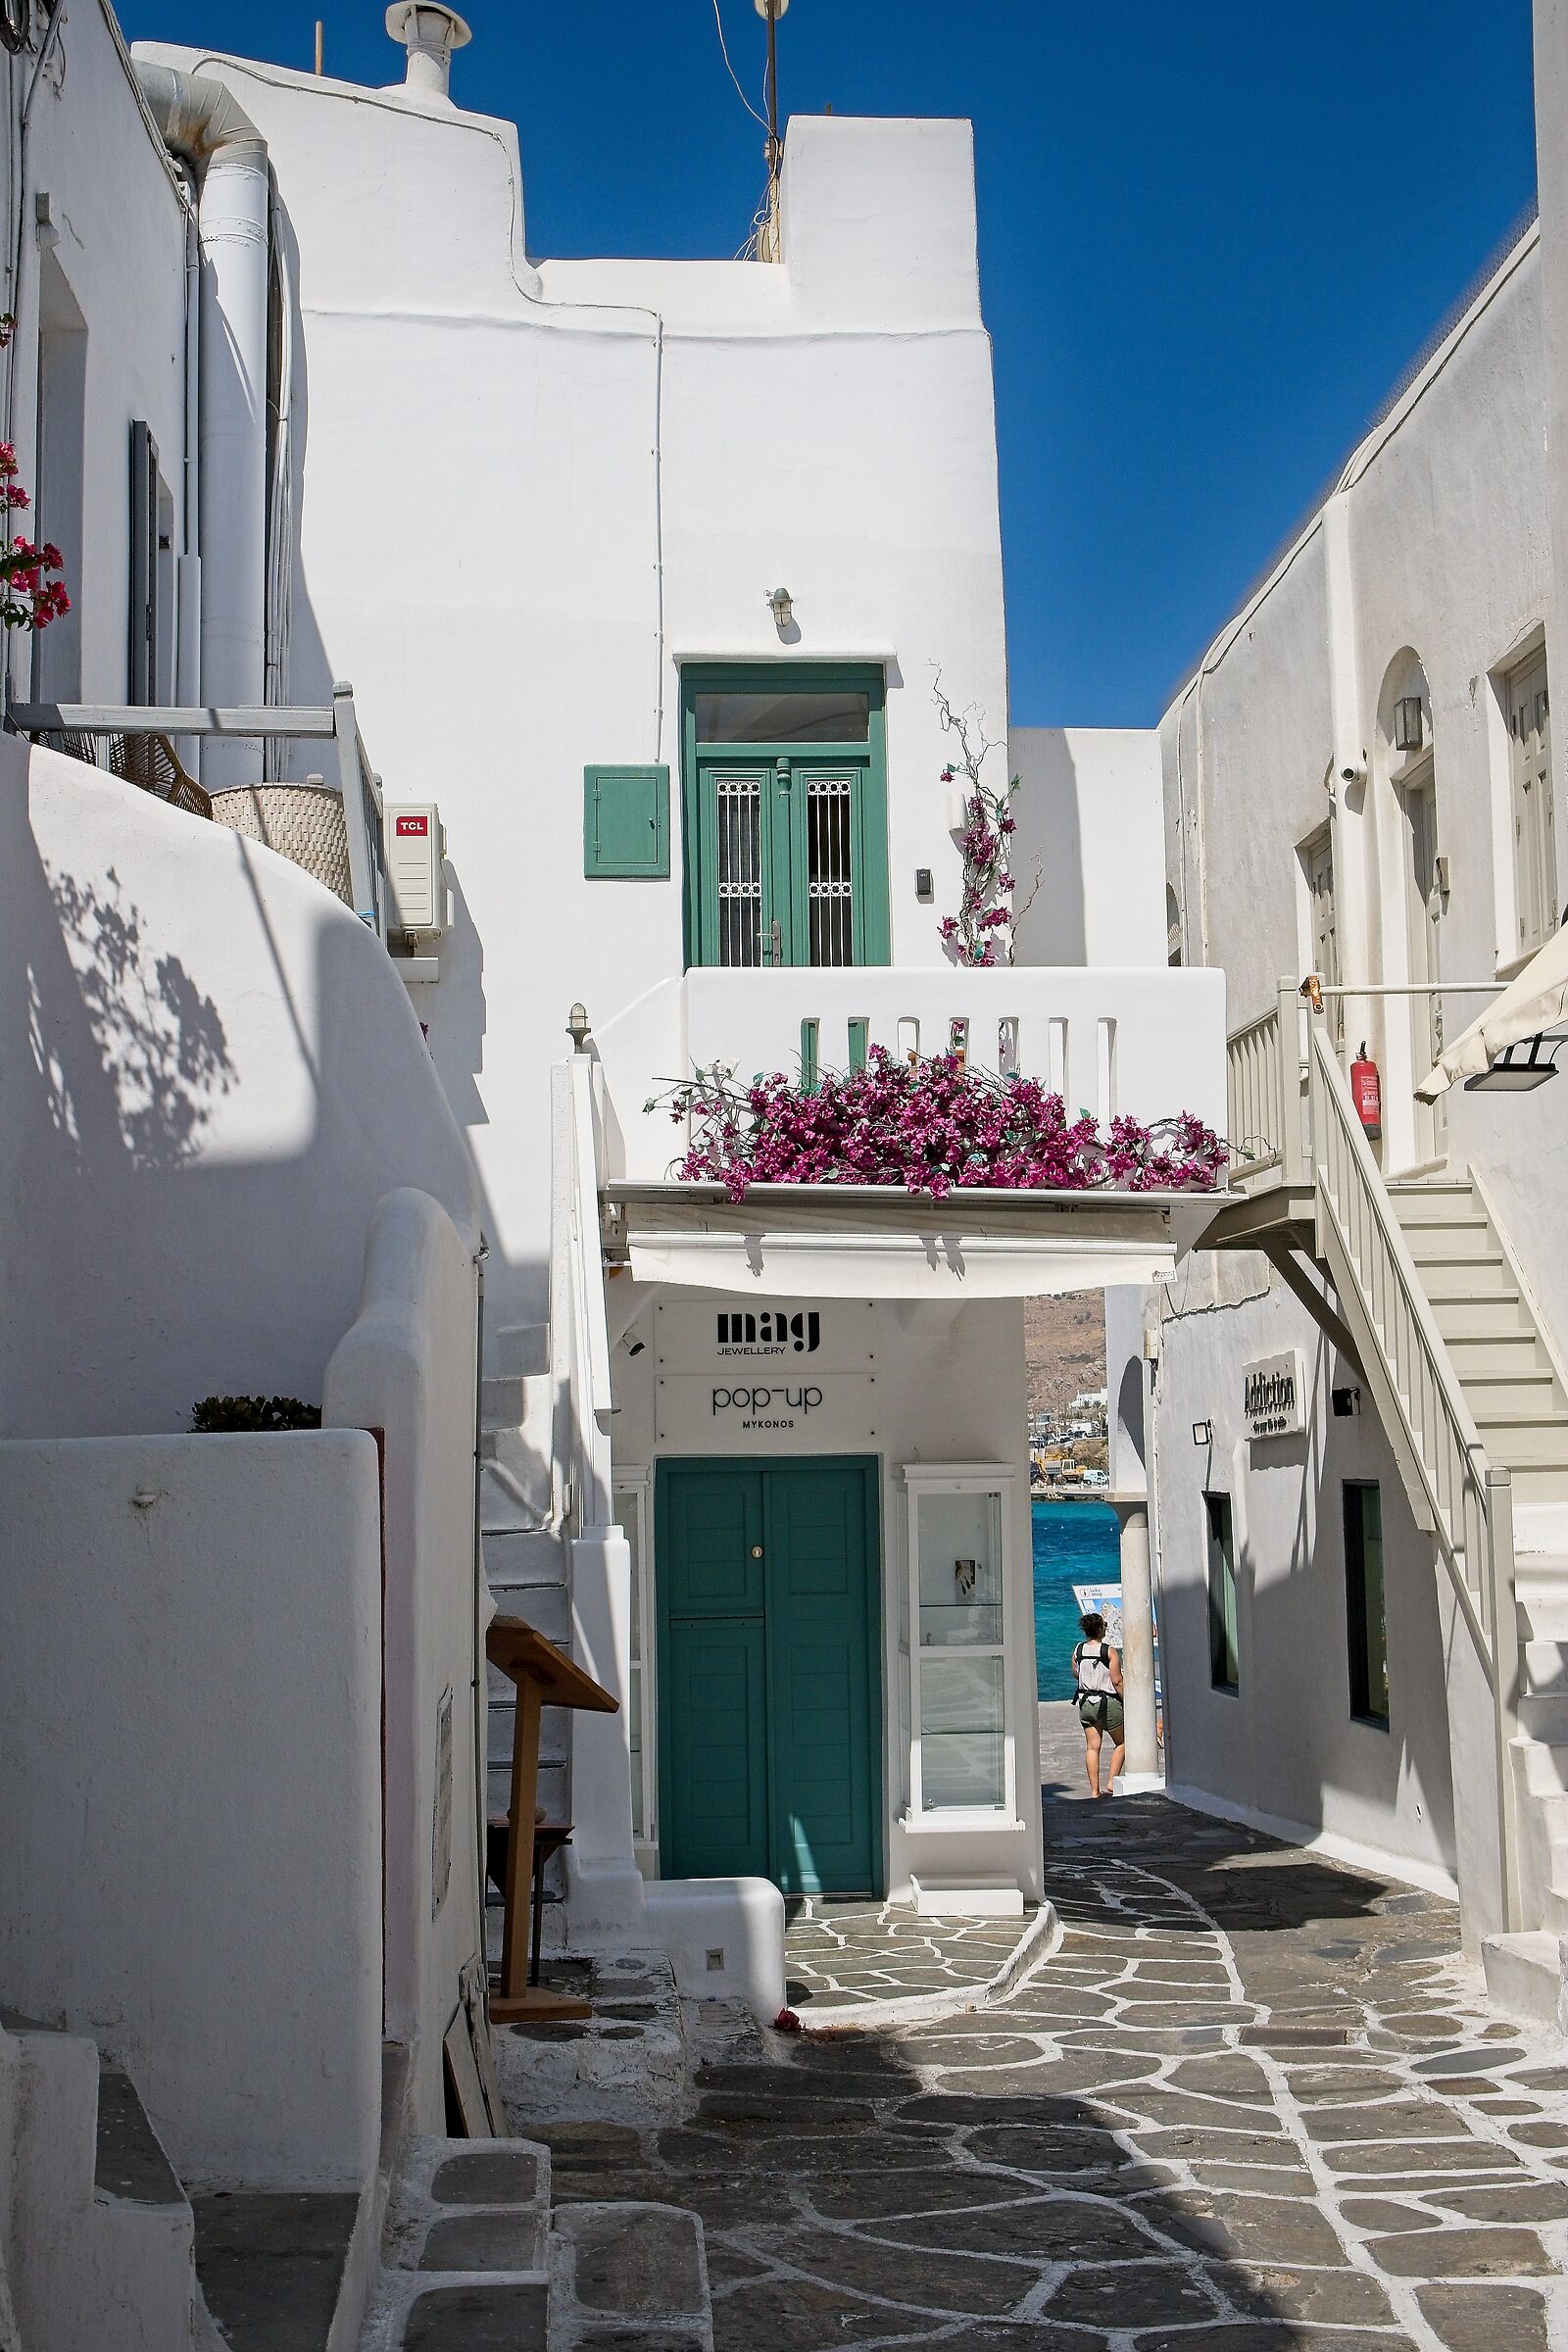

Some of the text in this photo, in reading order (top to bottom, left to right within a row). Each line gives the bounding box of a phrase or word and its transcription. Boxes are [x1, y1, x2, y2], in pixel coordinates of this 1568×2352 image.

[400, 821, 424, 831] TCL
[717, 1311, 820, 1352] mag
[717, 1347, 787, 1355] JEWELLERY
[712, 1387, 823, 1415] pop-up
[742, 1420, 795, 1429] MYKONOS
